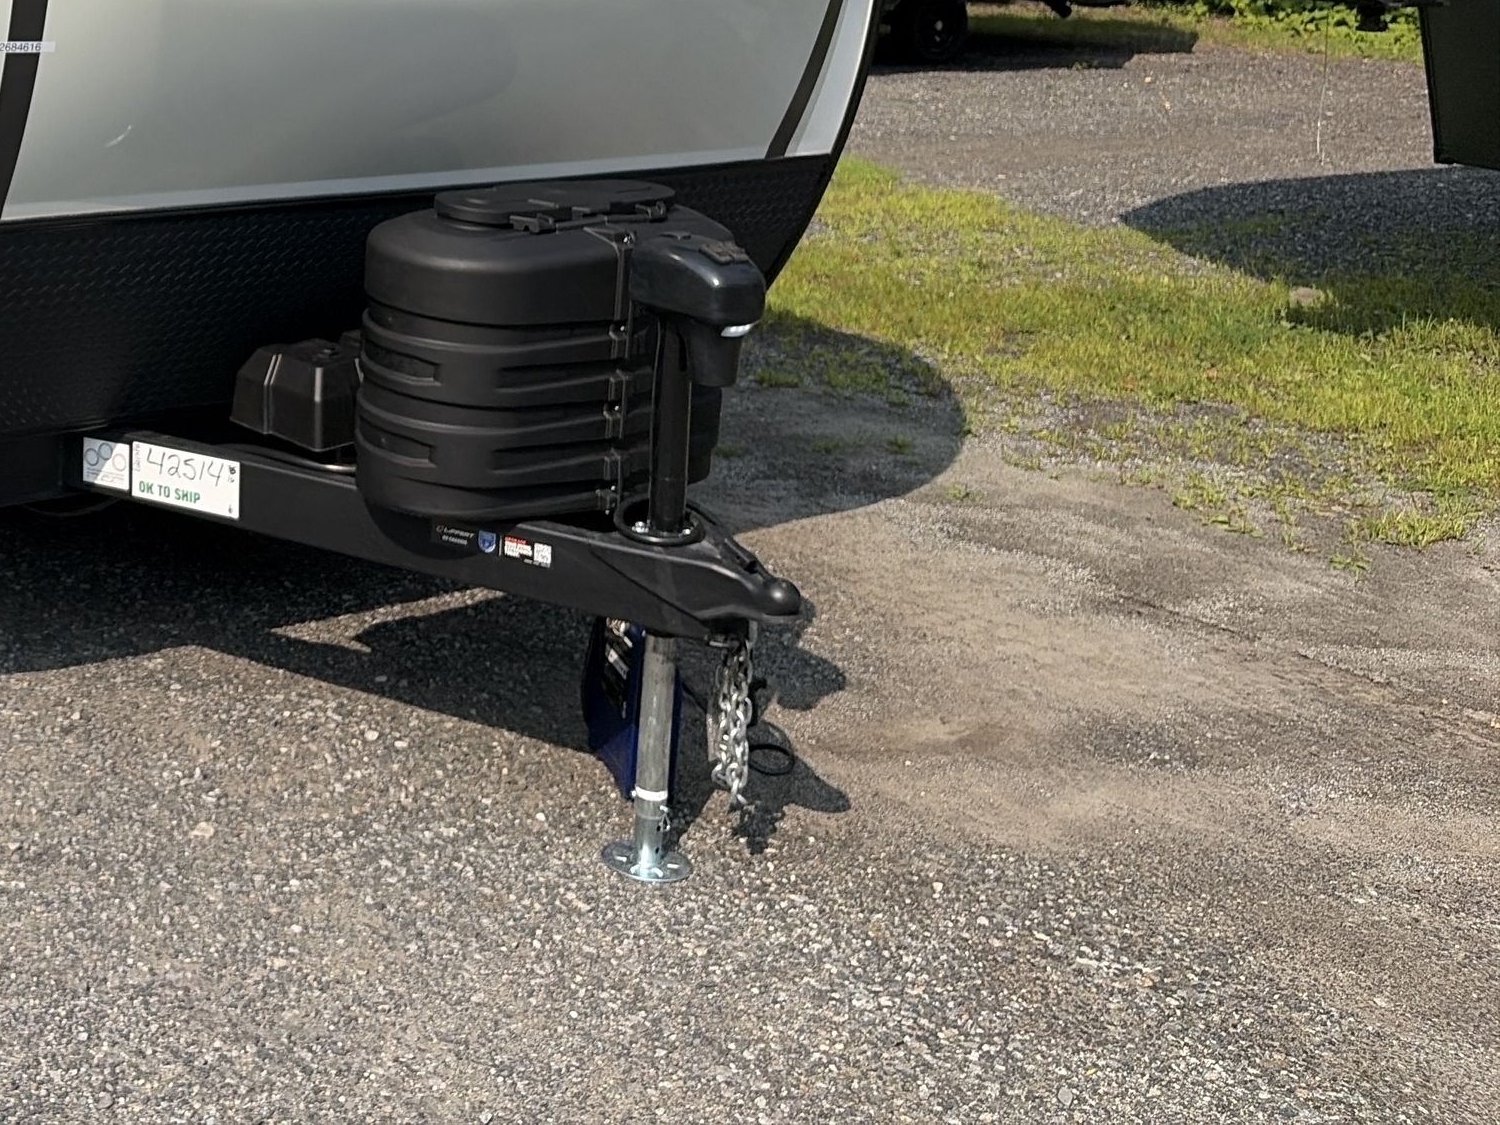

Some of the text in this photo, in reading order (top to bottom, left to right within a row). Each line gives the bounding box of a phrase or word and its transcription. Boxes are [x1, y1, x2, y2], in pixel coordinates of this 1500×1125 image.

[146, 448, 224, 487] 42514
[138, 480, 201, 504] OK TO SHIP
